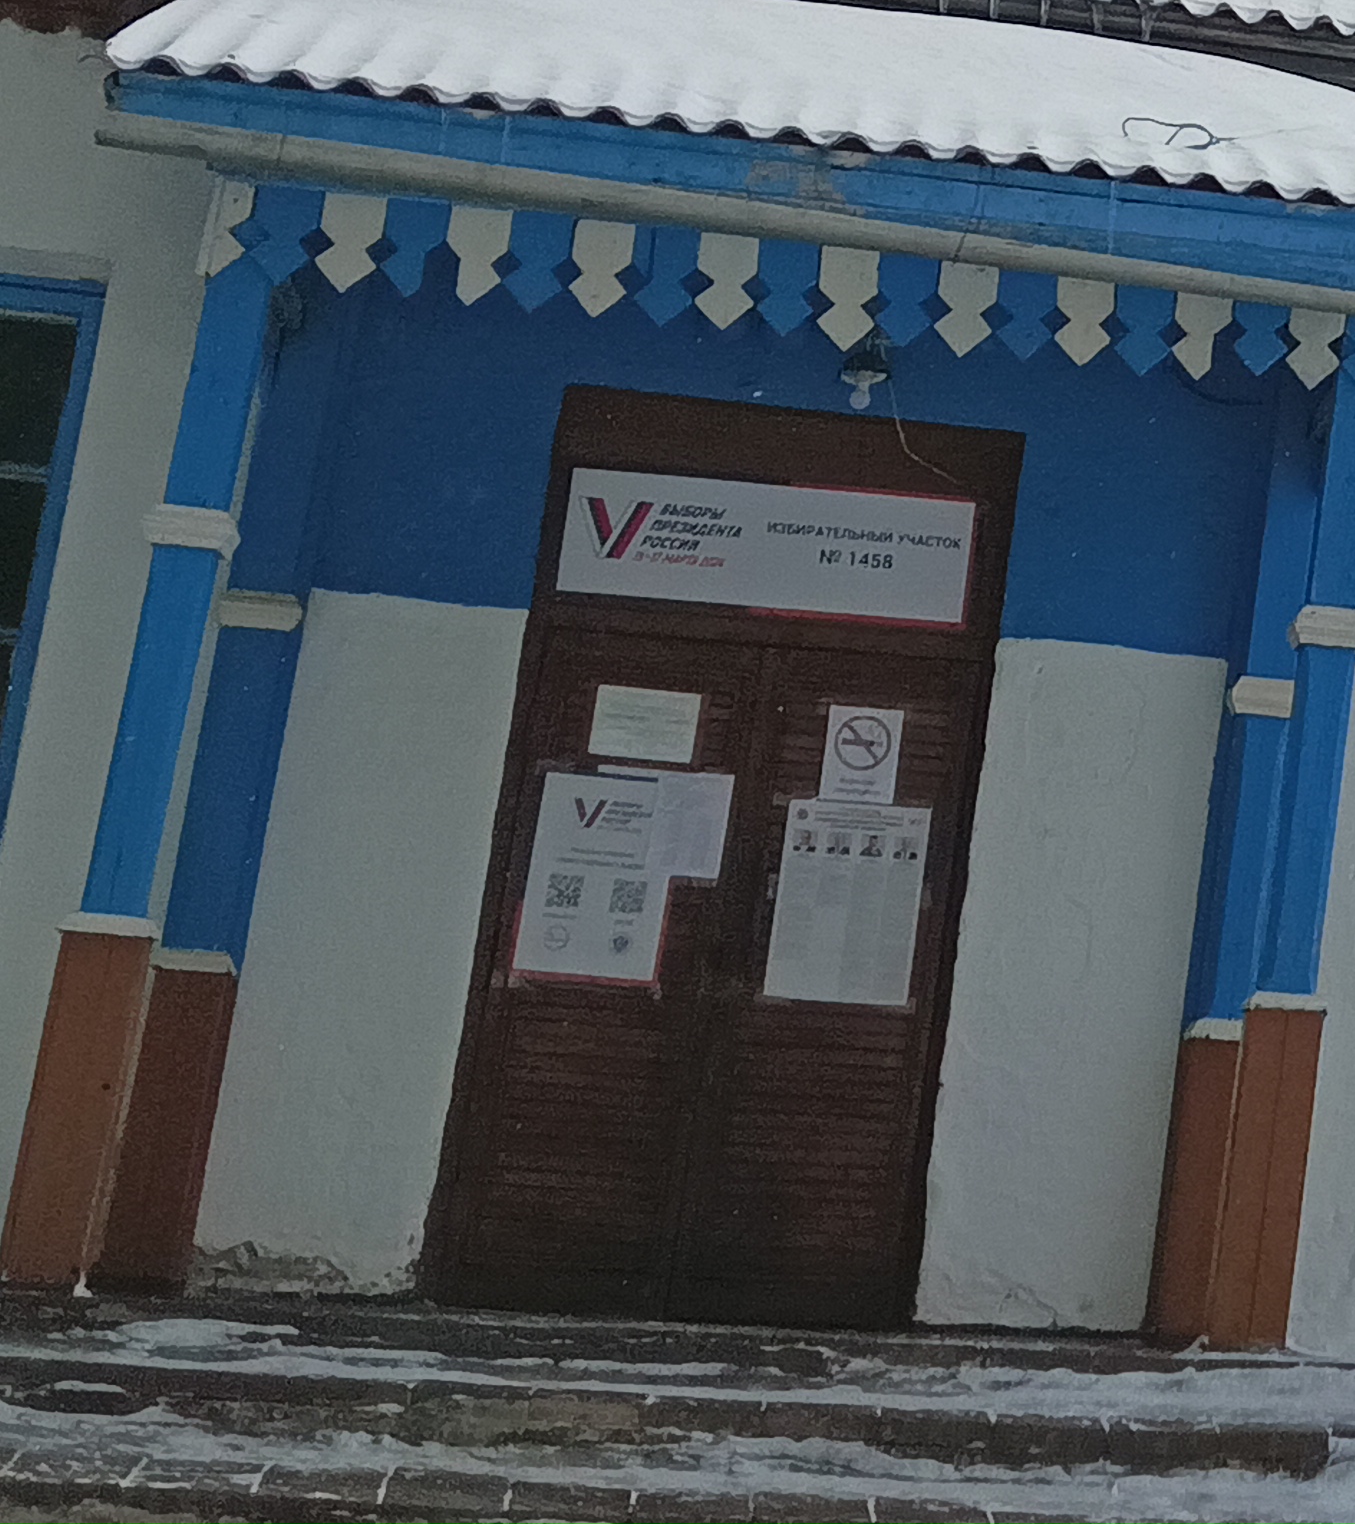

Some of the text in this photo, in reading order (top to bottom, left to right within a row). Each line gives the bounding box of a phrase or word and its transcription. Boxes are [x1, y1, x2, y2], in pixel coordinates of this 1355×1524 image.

[659, 502, 728, 521] ВЫБОРЫ
[648, 519, 743, 538] ПРЕЗИДЕНТА
[767, 519, 961, 551] ИЗБИРАТЕЛЬНЫЙ УЧАСТОК
[819, 549, 894, 570] № 1458
